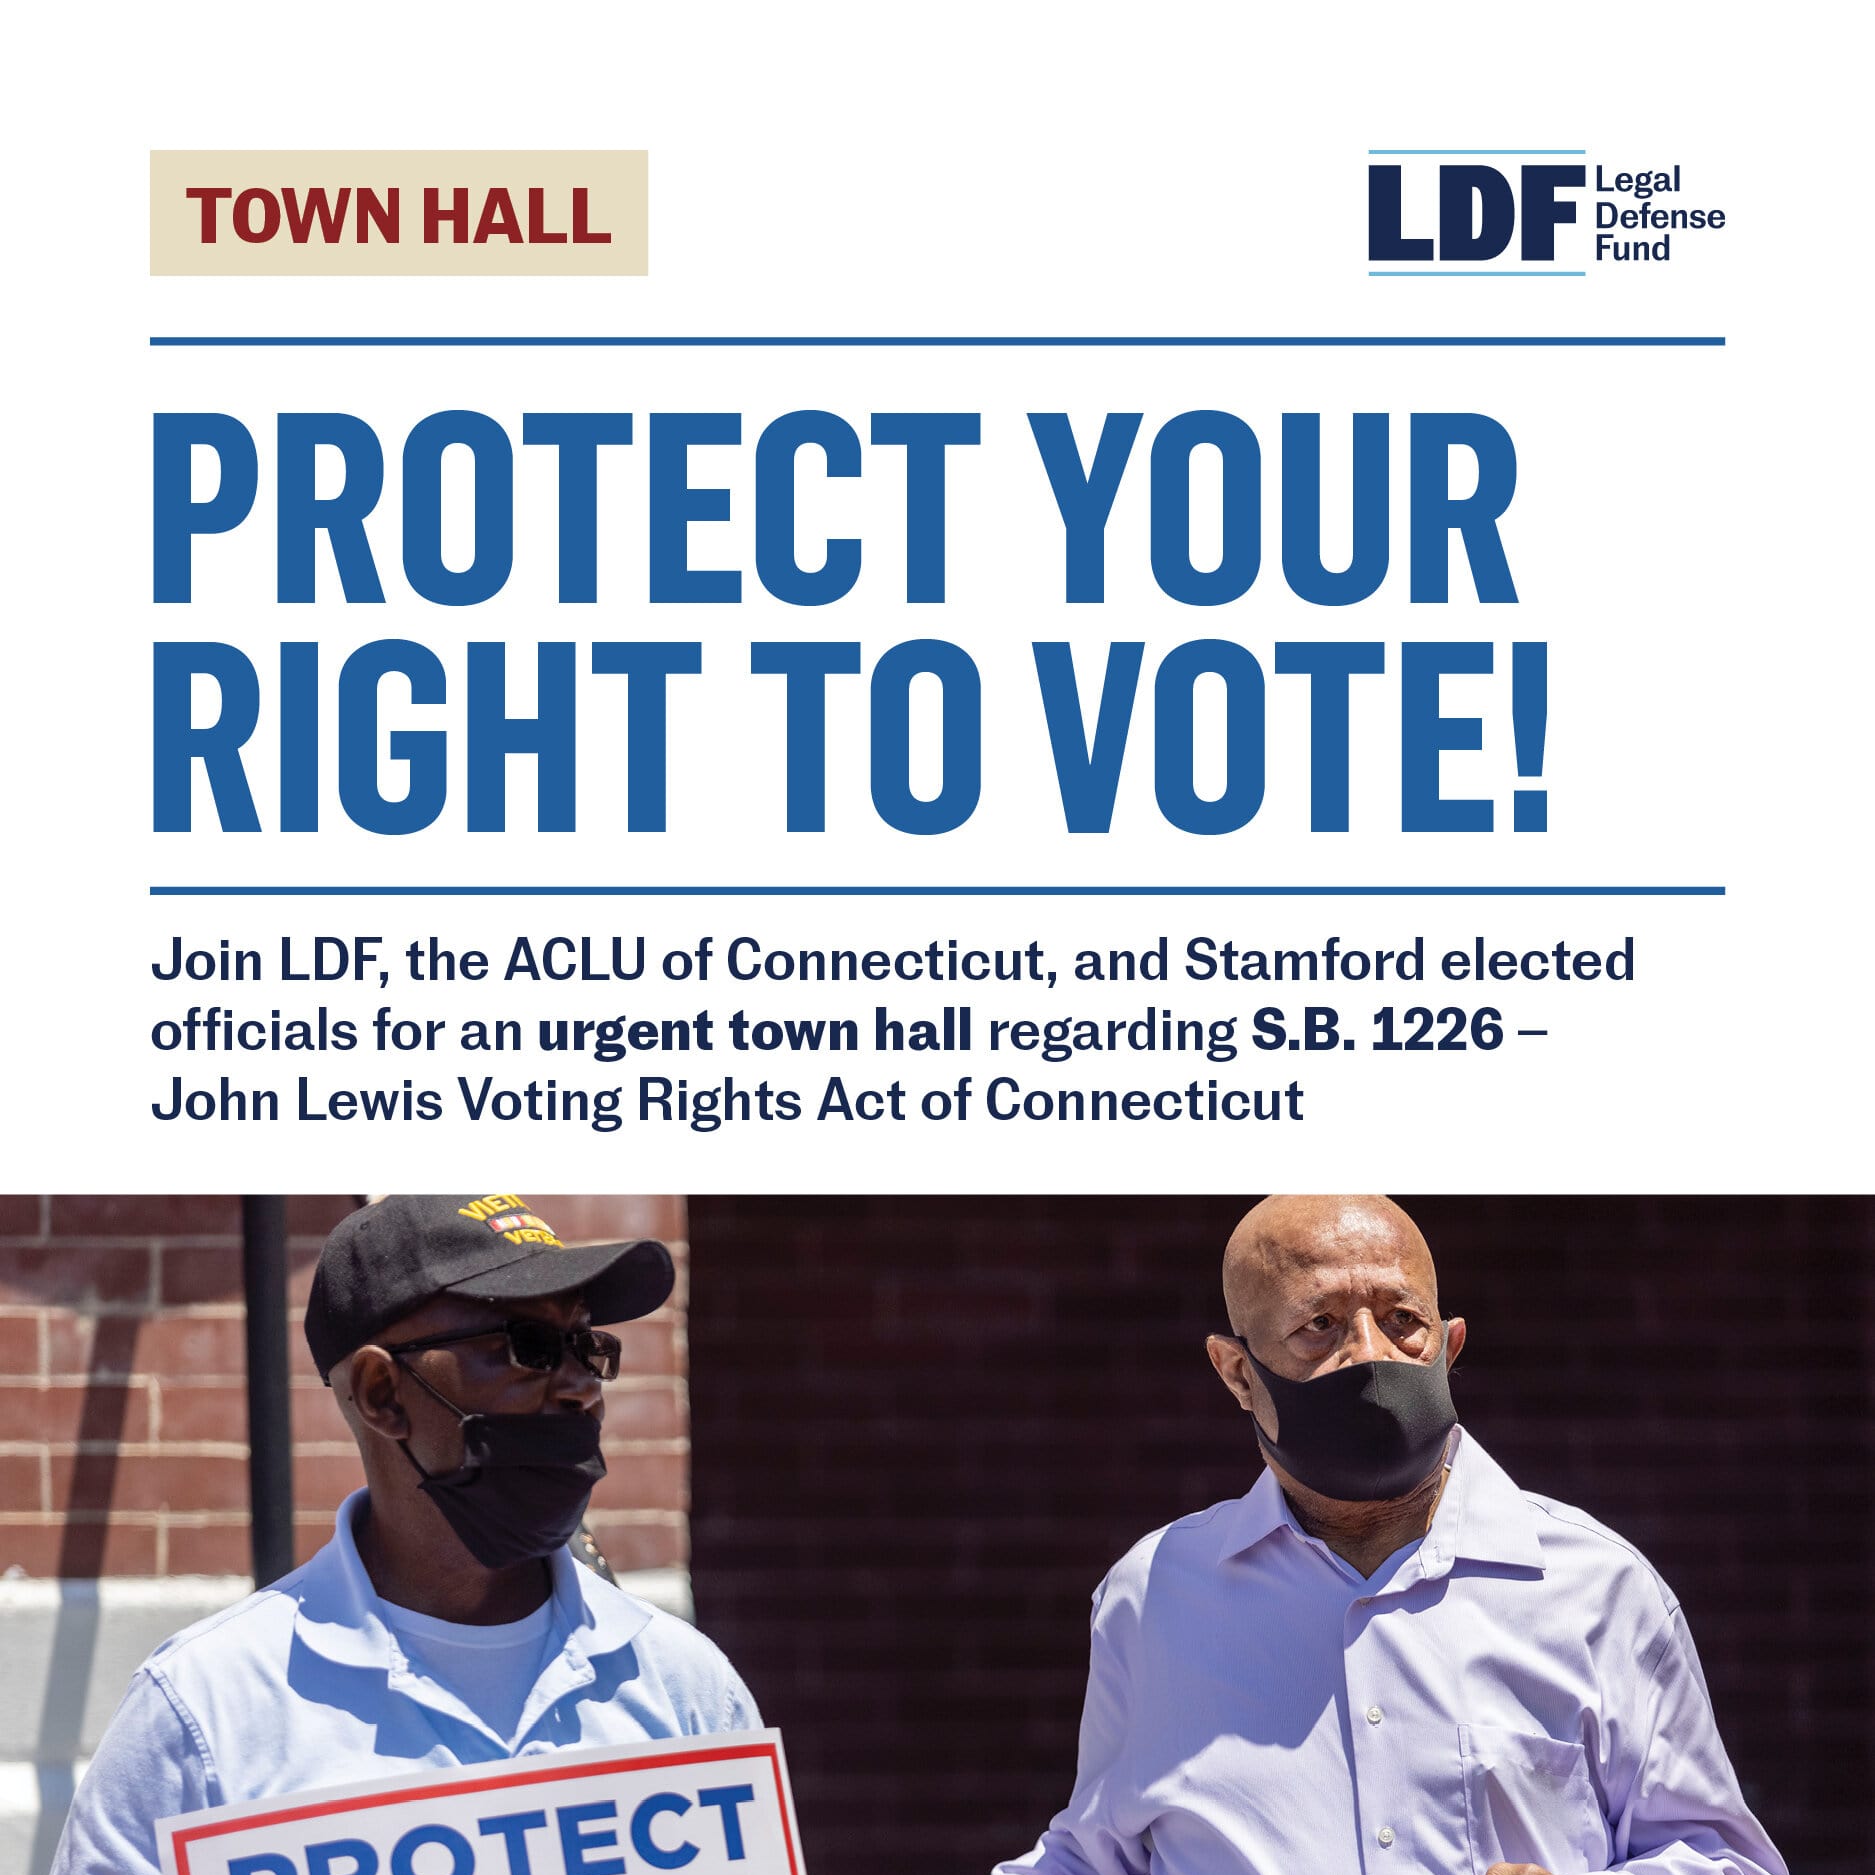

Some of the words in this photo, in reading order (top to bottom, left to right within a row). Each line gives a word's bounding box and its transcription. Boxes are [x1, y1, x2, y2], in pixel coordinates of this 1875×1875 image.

[1596, 164, 1680, 199] Legal
[186, 188, 399, 243] TOWN
[424, 188, 611, 243] HALL
[1368, 164, 1585, 261] LDF
[1596, 201, 1725, 229] Defense
[1596, 234, 1670, 261] Fund
[153, 410, 981, 606] PROTECT
[1026, 410, 1520, 606] YOUR
[152, 639, 702, 835] RIGHT
[751, 639, 981, 835] TO
[1032, 639, 1547, 835] VOTE!
[152, 936, 261, 981] Join
[281, 936, 388, 988] LDF,
[405, 936, 488, 981] the
[504, 936, 644, 981] ACLU
[662, 936, 713, 981] of
[728, 936, 1056, 988] Connecticut,
[1075, 936, 1168, 981] and
[1185, 936, 1424, 981] Stamford
[1441, 936, 1634, 981] elected
[151, 1006, 357, 1051] officials
[372, 1007, 445, 1051] for
[461, 1020, 521, 1051] an
[539, 1009, 714, 1062] urgent
[728, 1009, 858, 1051] town
[875, 1007, 971, 1051] hall
[990, 1007, 1237, 1062] regarding
[1252, 1007, 1355, 1051] S.B.
[1372, 1007, 1503, 1051] 1226
[152, 1077, 278, 1121] John
[299, 1077, 442, 1121] Lewis
[456, 1076, 622, 1132] Voting
[640, 1077, 801, 1132] Rights
[817, 1077, 906, 1121] Act
[921, 1077, 972, 1121] of
[987, 1077, 1304, 1121] Connecticut
